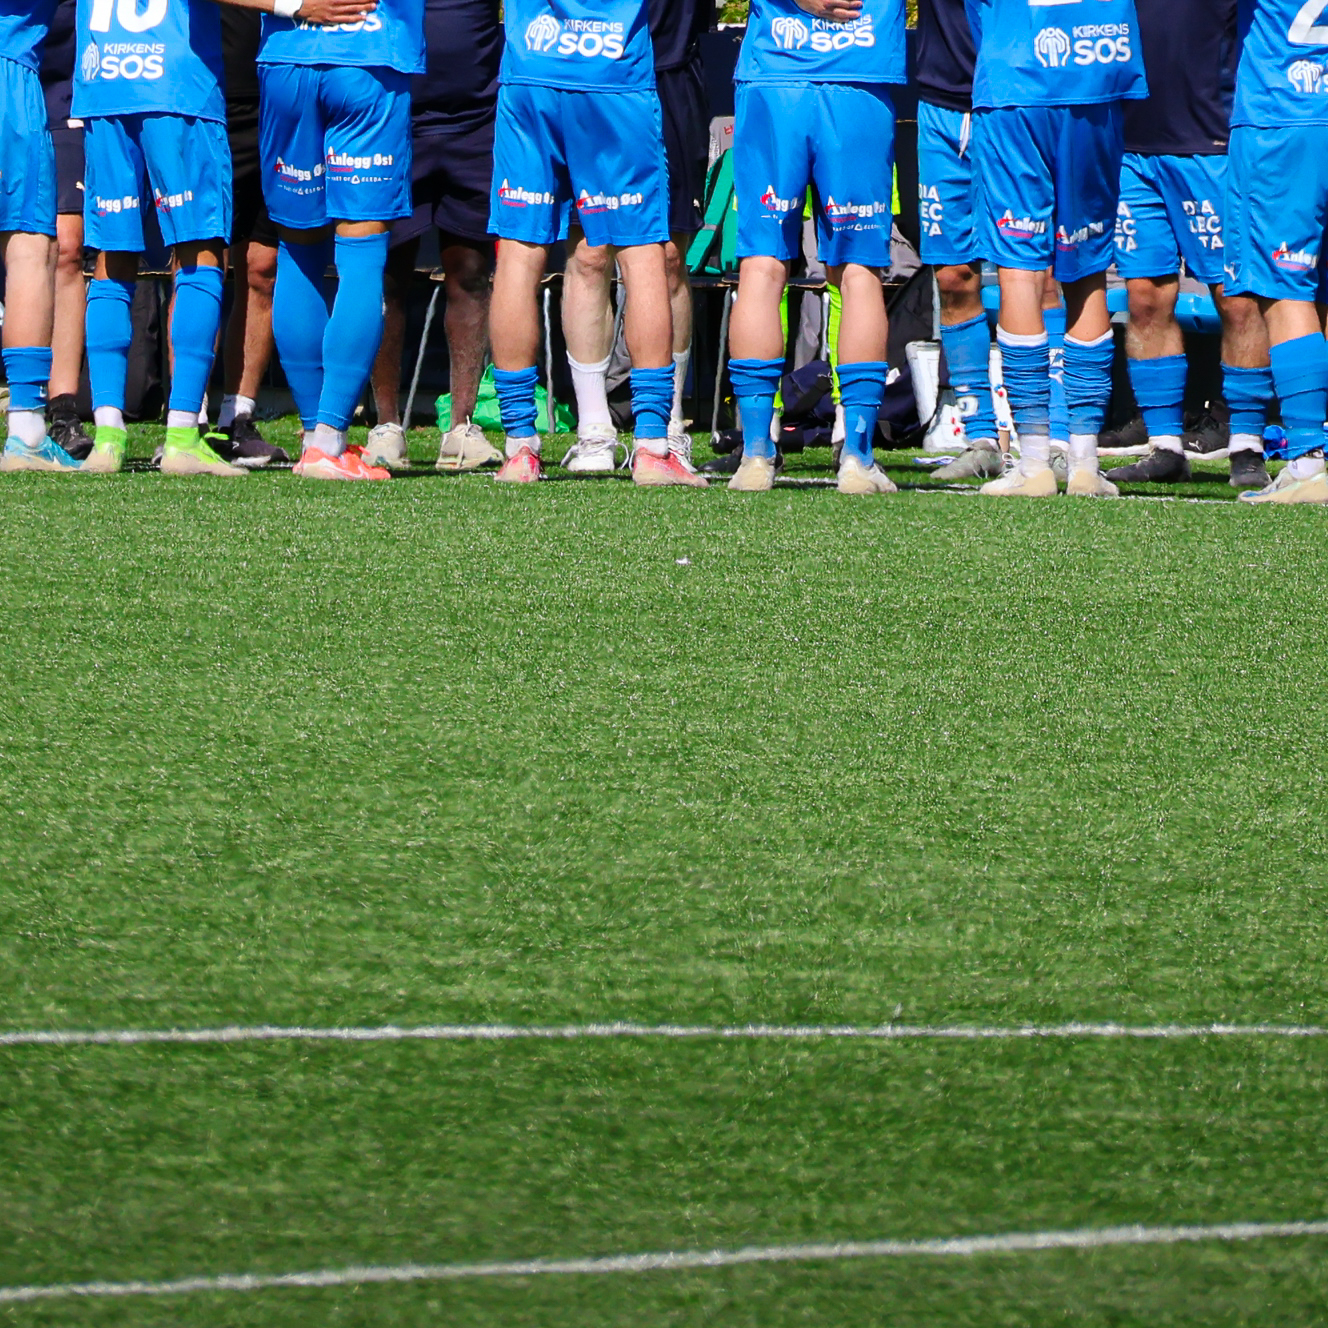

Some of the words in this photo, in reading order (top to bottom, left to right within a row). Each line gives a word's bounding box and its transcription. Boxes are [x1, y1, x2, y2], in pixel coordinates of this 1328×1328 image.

[564, 18, 624, 33] KIRKENS
[1072, 23, 1130, 38] KIRKENS
[103, 42, 166, 55] KIRKENS
[557, 33, 625, 60] SOS
[811, 25, 875, 53] SOS
[1073, 37, 1132, 66] SOS
[100, 55, 165, 80] SOS
[327, 146, 372, 169] Anlegg
[373, 153, 393, 166] Øst
[620, 192, 643, 206] Øst
[1189, 215, 1222, 234] LEC
[1198, 234, 1224, 250] TA
